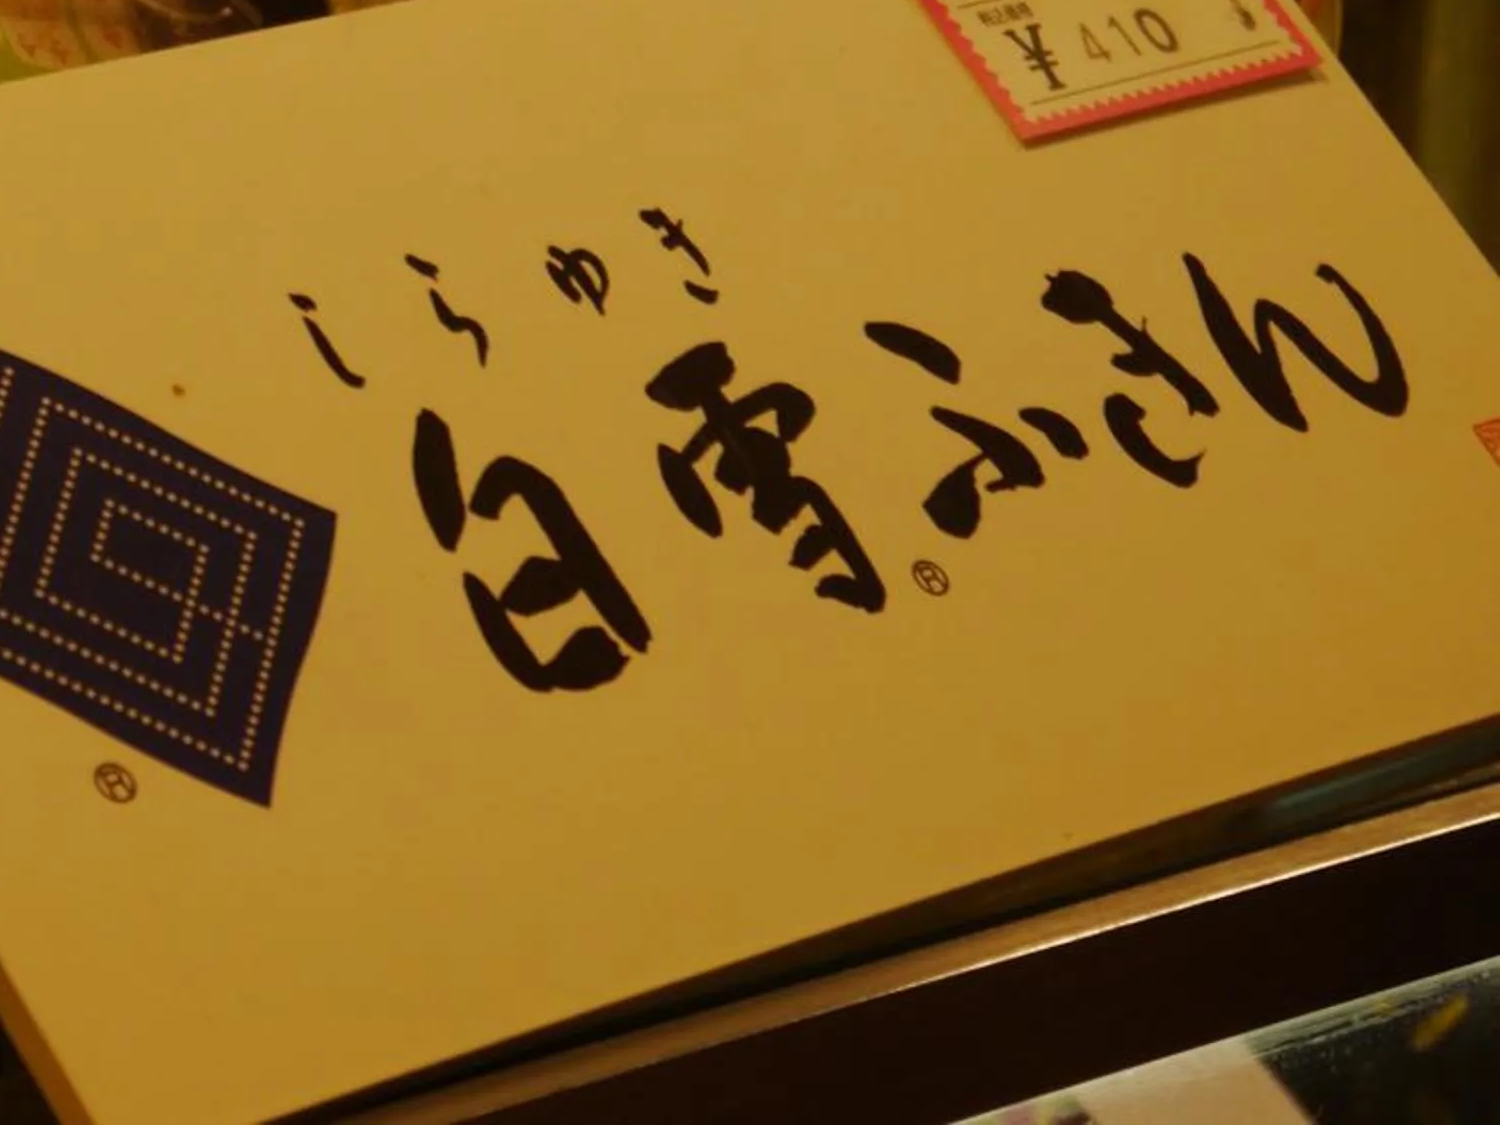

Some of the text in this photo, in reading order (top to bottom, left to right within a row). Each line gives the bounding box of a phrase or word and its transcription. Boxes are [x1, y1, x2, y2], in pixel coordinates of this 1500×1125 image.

[1078, 8, 1178, 65] 410
[412, 251, 1409, 693] 白雪ふきん
